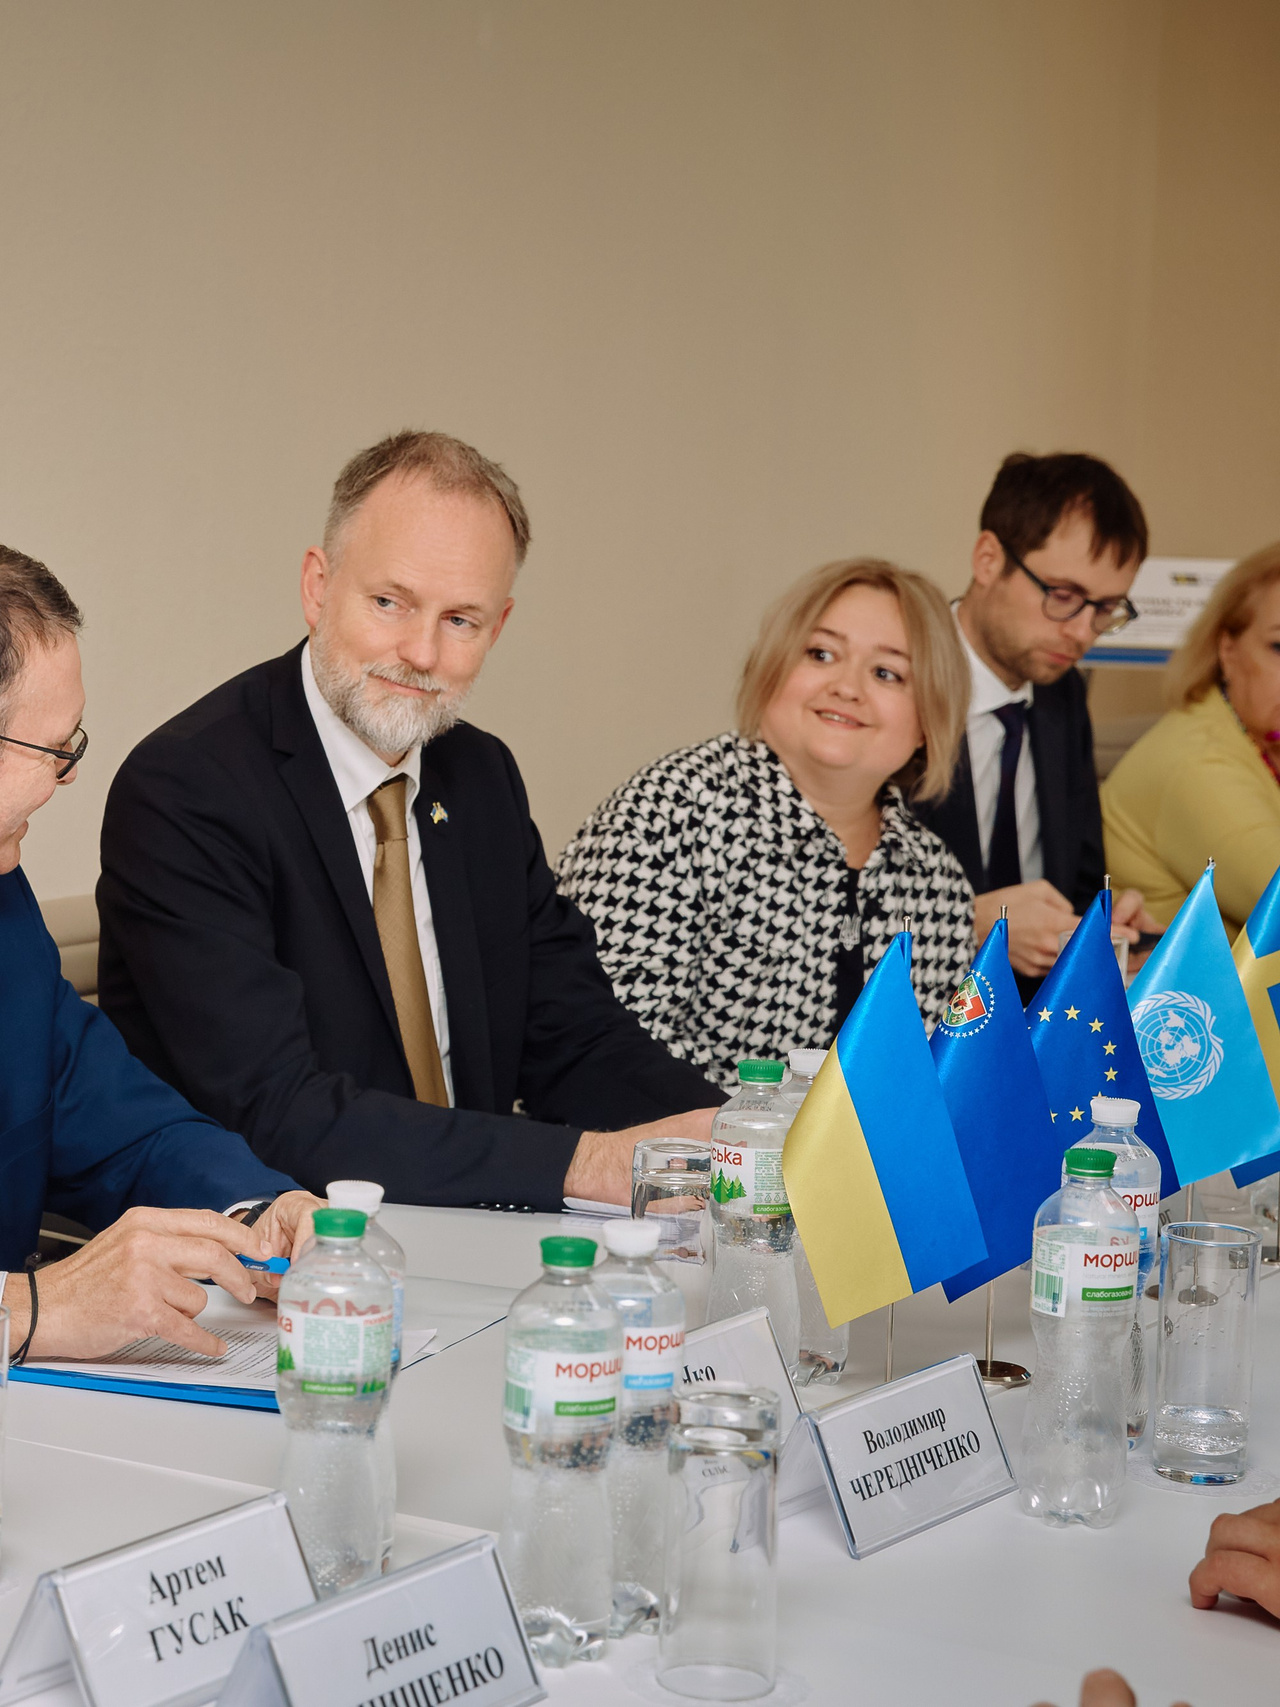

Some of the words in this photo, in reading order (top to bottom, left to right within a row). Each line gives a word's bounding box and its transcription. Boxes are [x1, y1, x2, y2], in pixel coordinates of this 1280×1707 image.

[862, 1408, 947, 1454] Володимир
[849, 1430, 981, 1501] ЧЕРЕДНІЧЕНКО
[149, 1555, 226, 1606] Артем
[148, 1596, 249, 1662] ГУСАК
[363, 1623, 438, 1678] Денис
